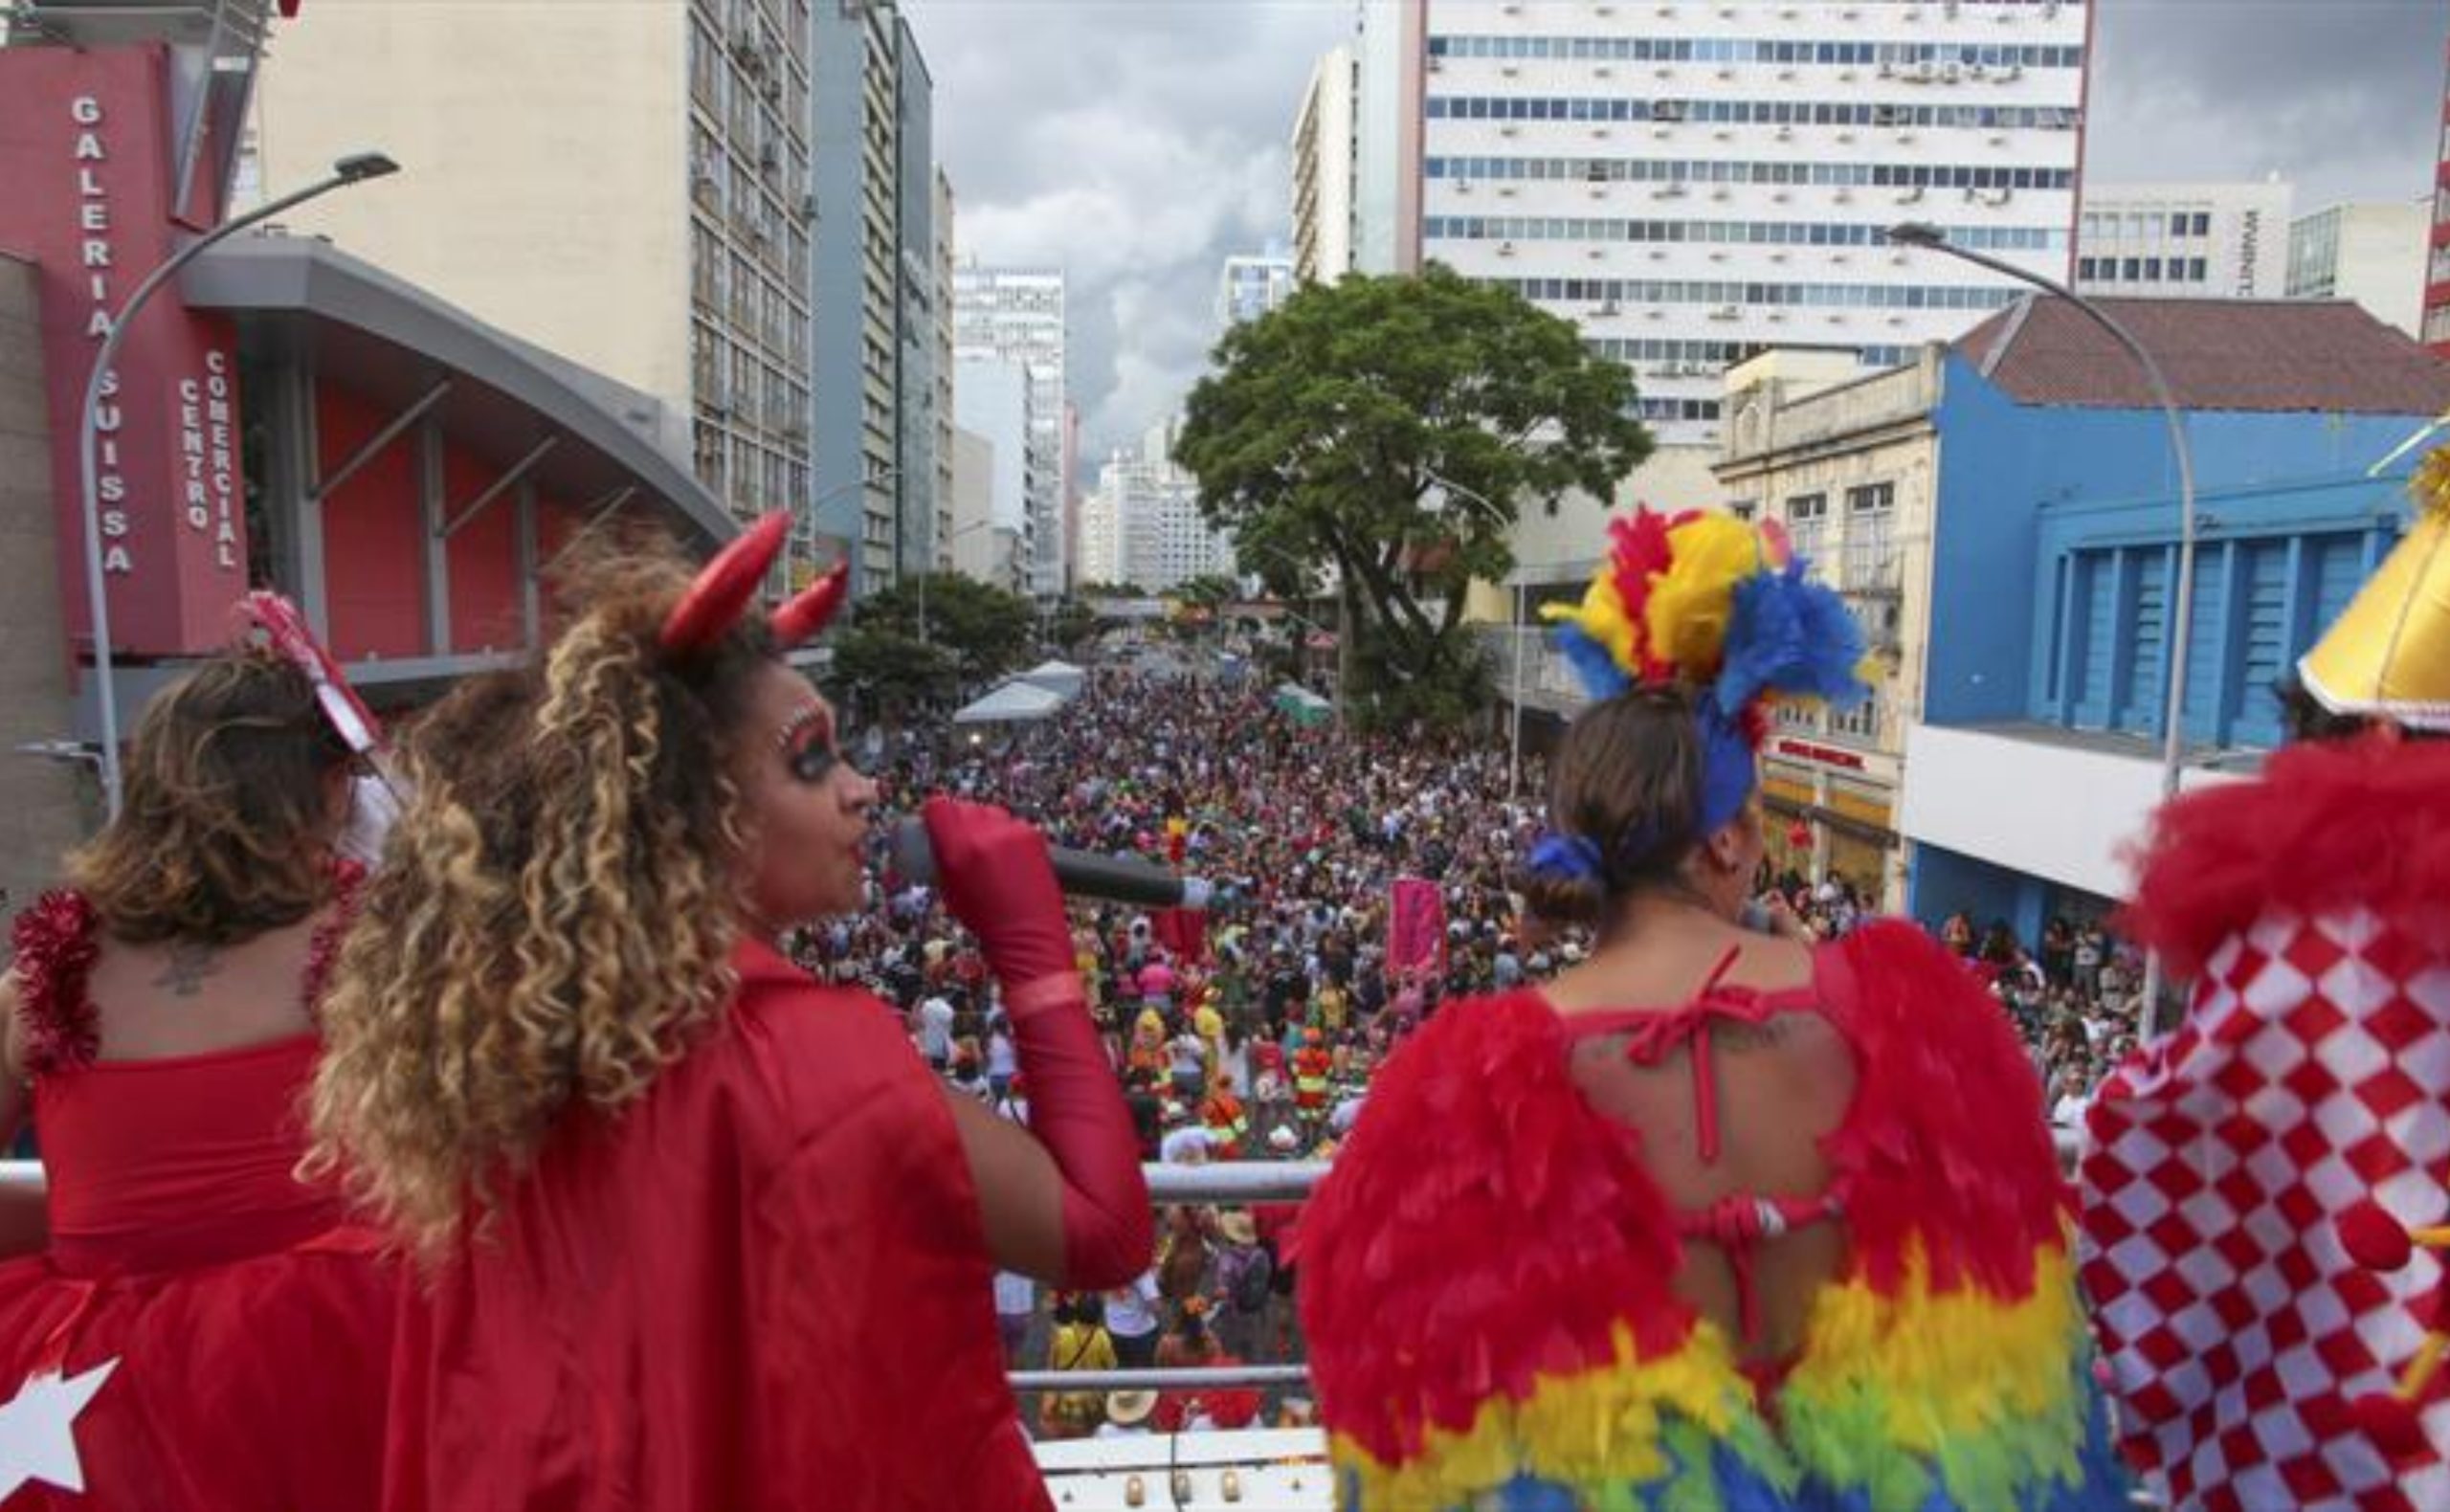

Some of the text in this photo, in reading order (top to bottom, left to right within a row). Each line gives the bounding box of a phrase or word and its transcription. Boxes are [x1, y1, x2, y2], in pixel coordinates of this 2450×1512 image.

[72, 97, 131, 570] GALERIA SUISSA
[180, 378, 208, 527] CENTRO
[207, 351, 235, 566] COMERCIAL
